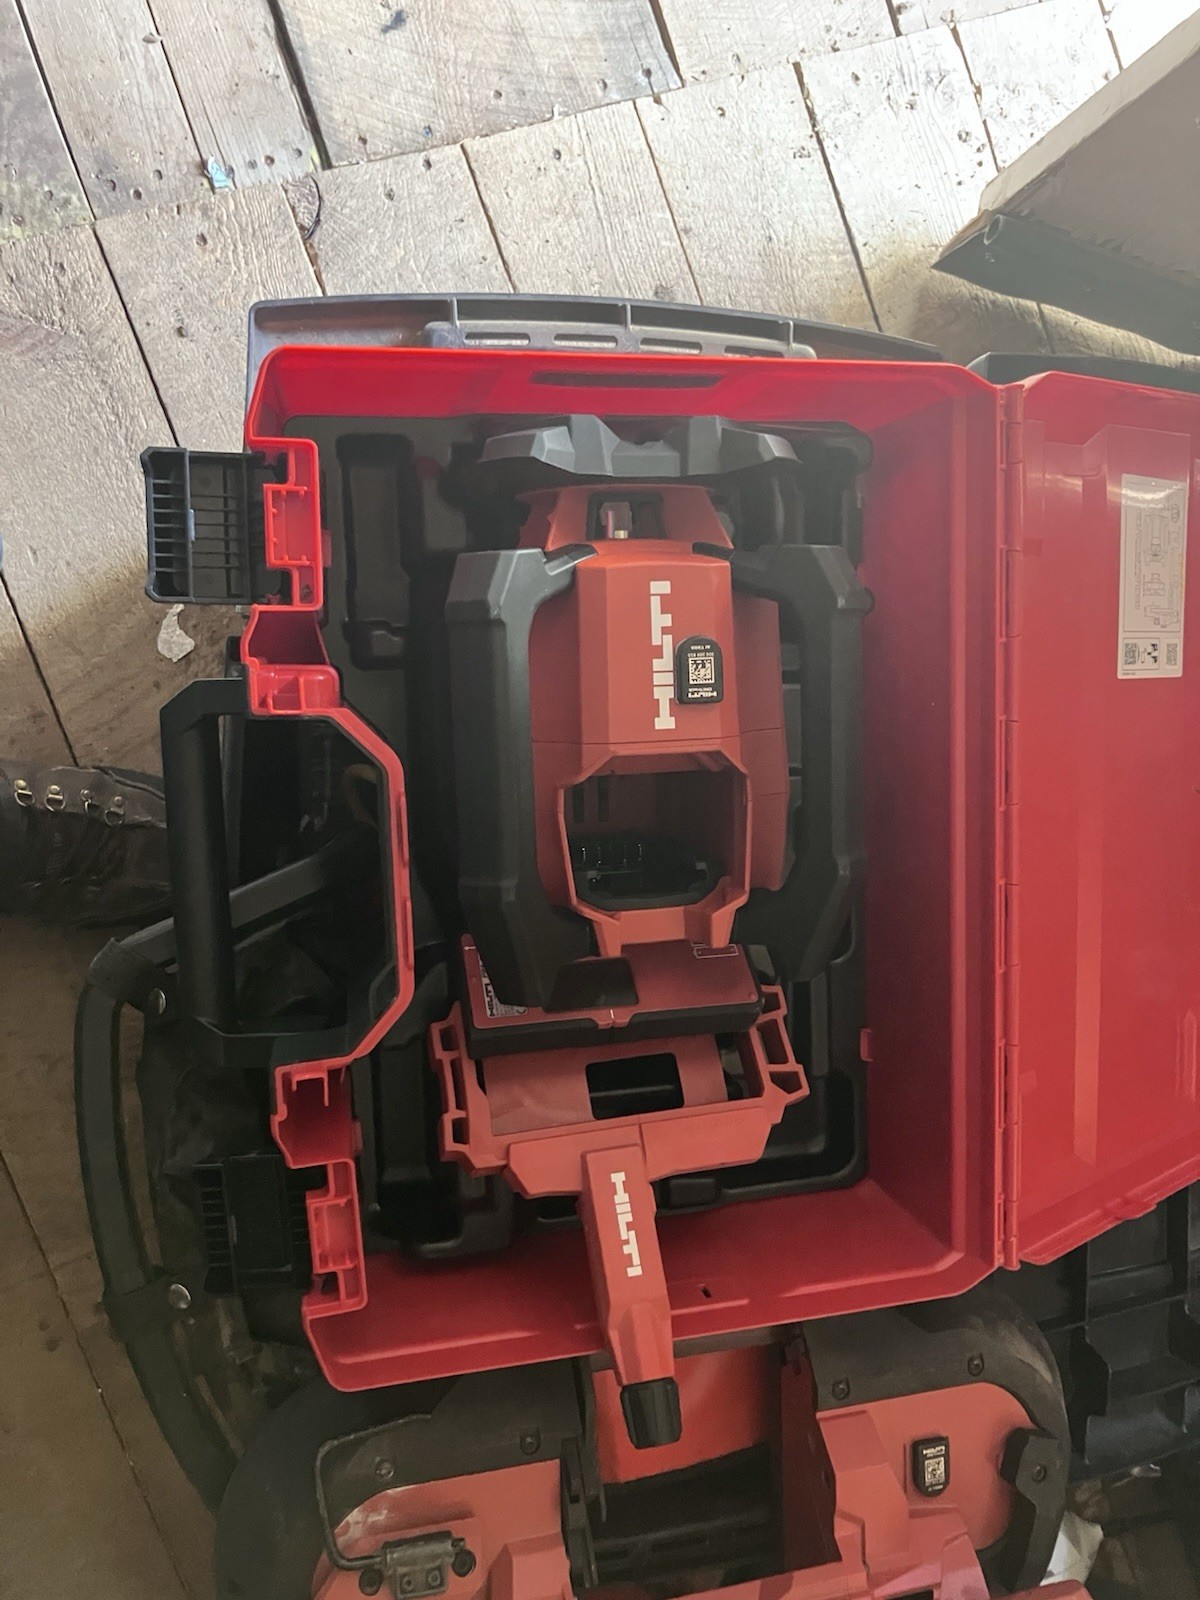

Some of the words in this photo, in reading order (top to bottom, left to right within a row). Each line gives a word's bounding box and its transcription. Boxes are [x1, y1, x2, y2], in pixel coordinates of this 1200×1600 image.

[650, 581, 676, 730] HILTI
[688, 690, 717, 698] HILTI
[484, 983, 495, 1017] HILTI
[610, 1171, 642, 1277] HILTI
